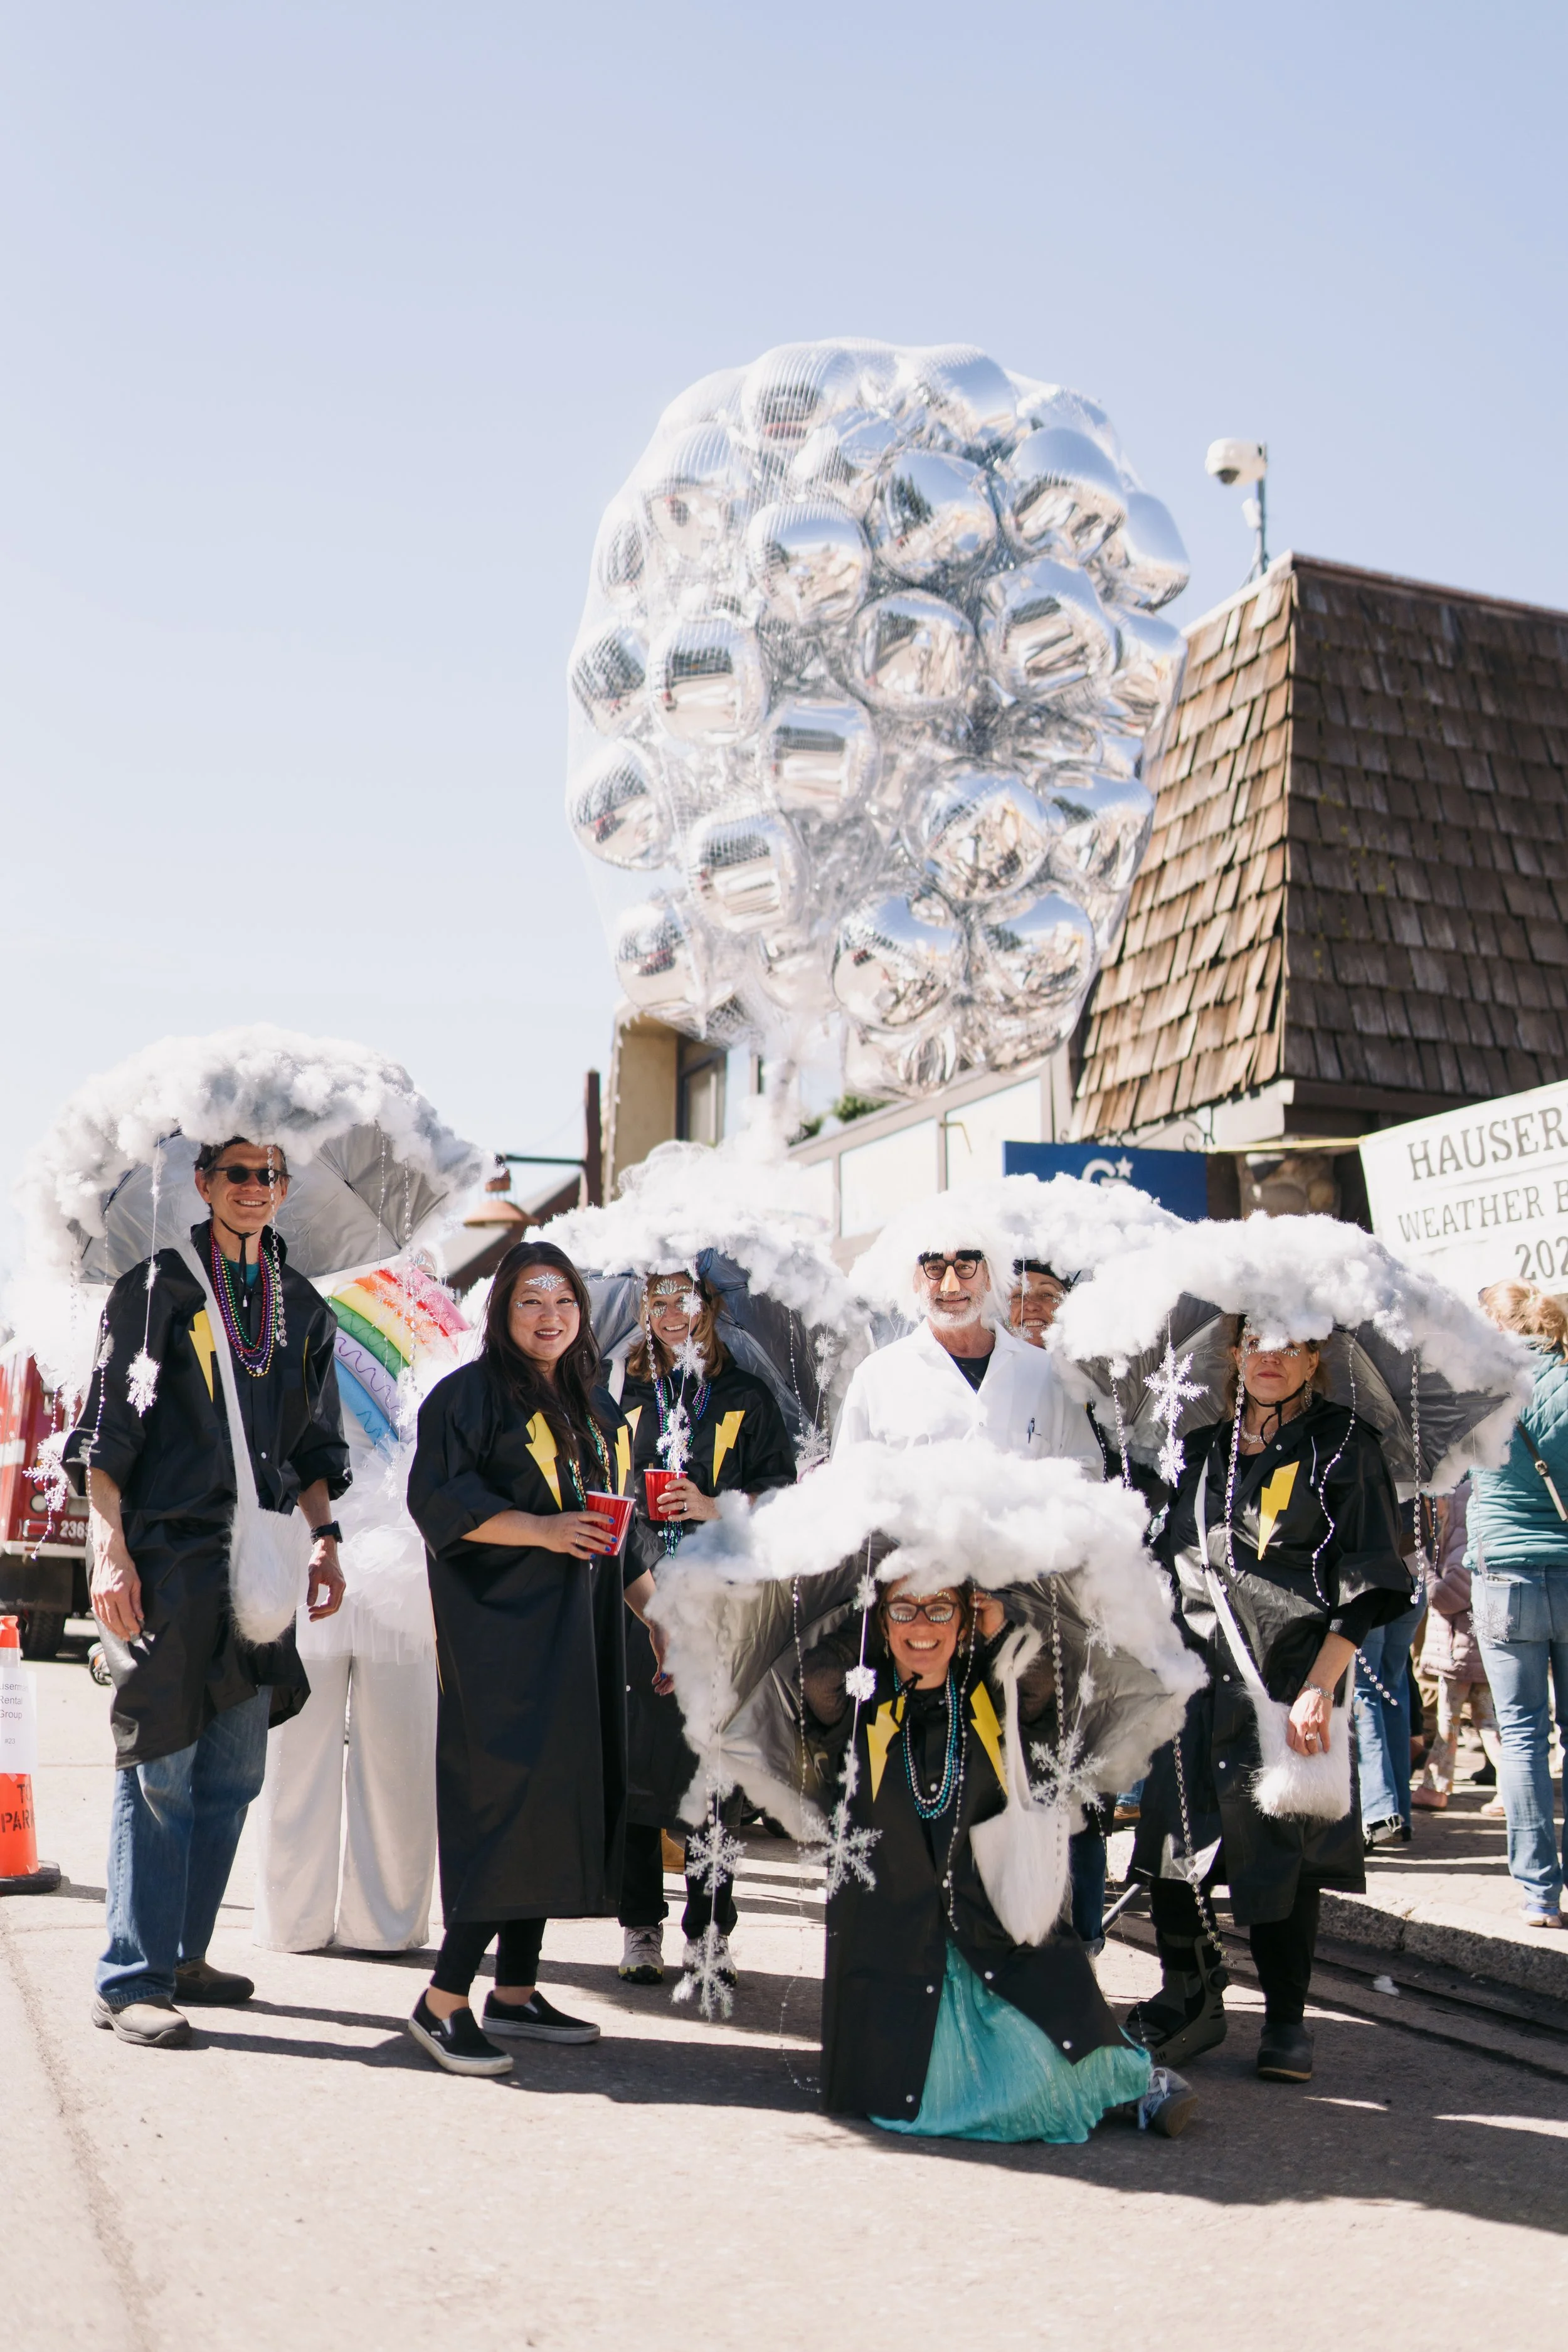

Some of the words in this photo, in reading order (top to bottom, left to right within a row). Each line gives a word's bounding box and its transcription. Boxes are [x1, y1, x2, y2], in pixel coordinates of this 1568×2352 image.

[1407, 1103, 1568, 1181] HAUSER
[1397, 1185, 1544, 1243] WEATHER
[0, 1695, 23, 1705] Rental
[0, 1709, 23, 1720] Group
